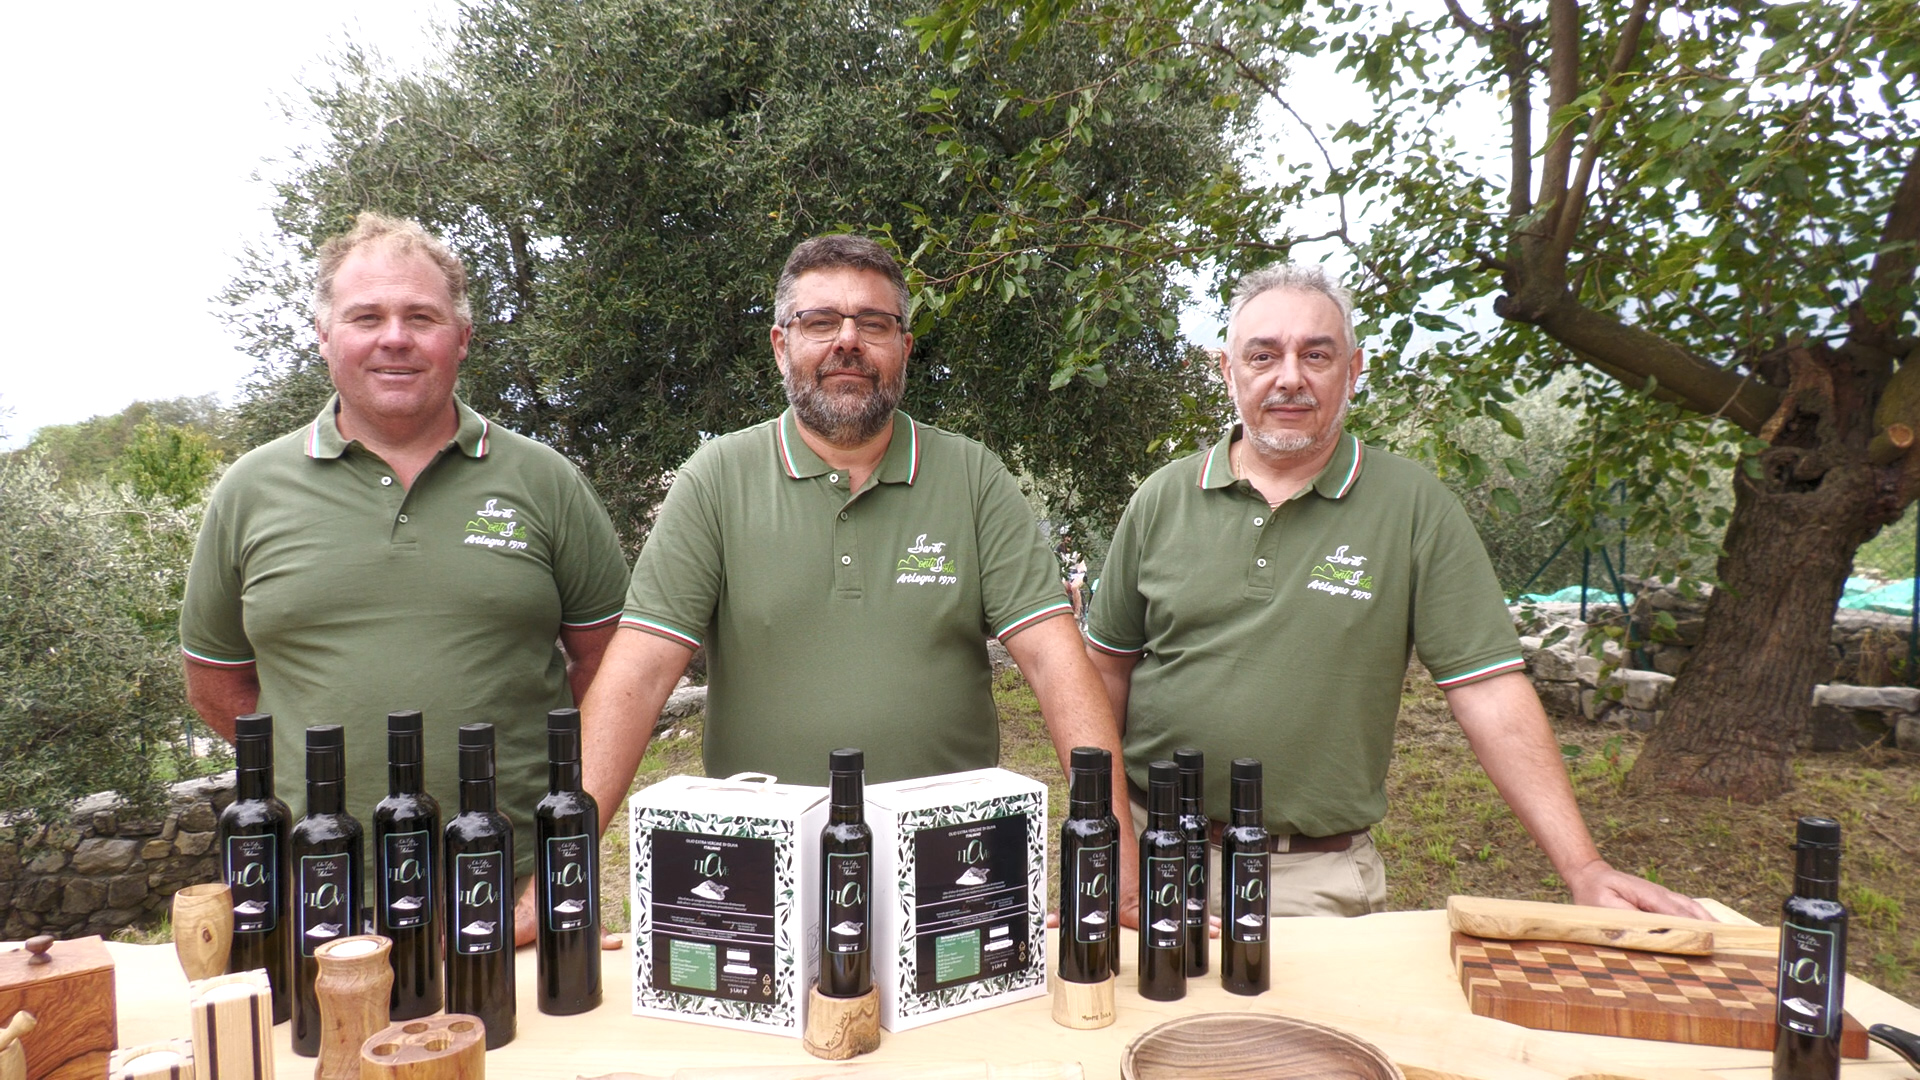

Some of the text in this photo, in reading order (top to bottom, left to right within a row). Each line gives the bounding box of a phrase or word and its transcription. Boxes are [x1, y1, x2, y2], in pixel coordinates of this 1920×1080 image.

[508, 540, 528, 549] 1970
[938, 575, 957, 585] 1970
[1351, 589, 1372, 600] 1970
